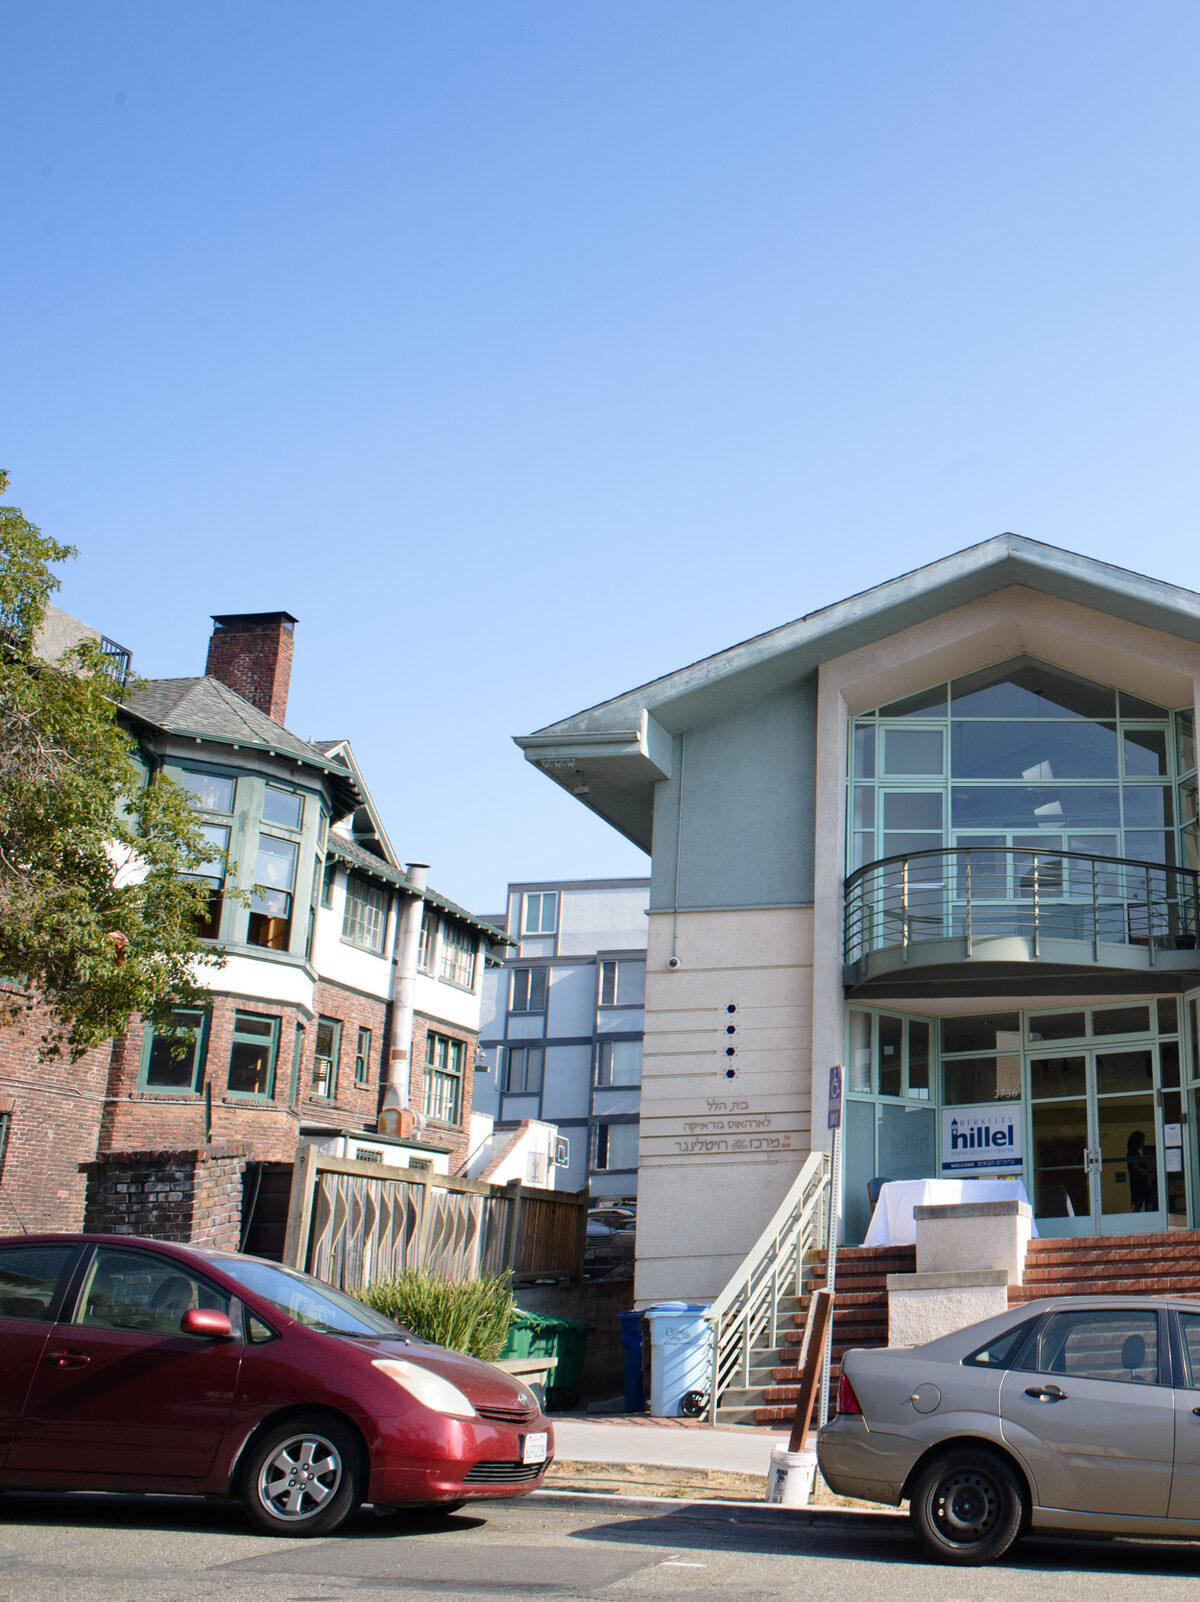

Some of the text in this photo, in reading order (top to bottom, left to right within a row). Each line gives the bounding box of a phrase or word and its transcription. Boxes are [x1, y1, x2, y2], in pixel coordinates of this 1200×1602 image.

[994, 1088, 1019, 1099] 2736
[706, 1099, 749, 1113] בית הלל
[960, 1116, 1014, 1126] BERKELEY
[951, 1124, 1014, 1149] hillel
[749, 1137, 781, 1149] מרכז
